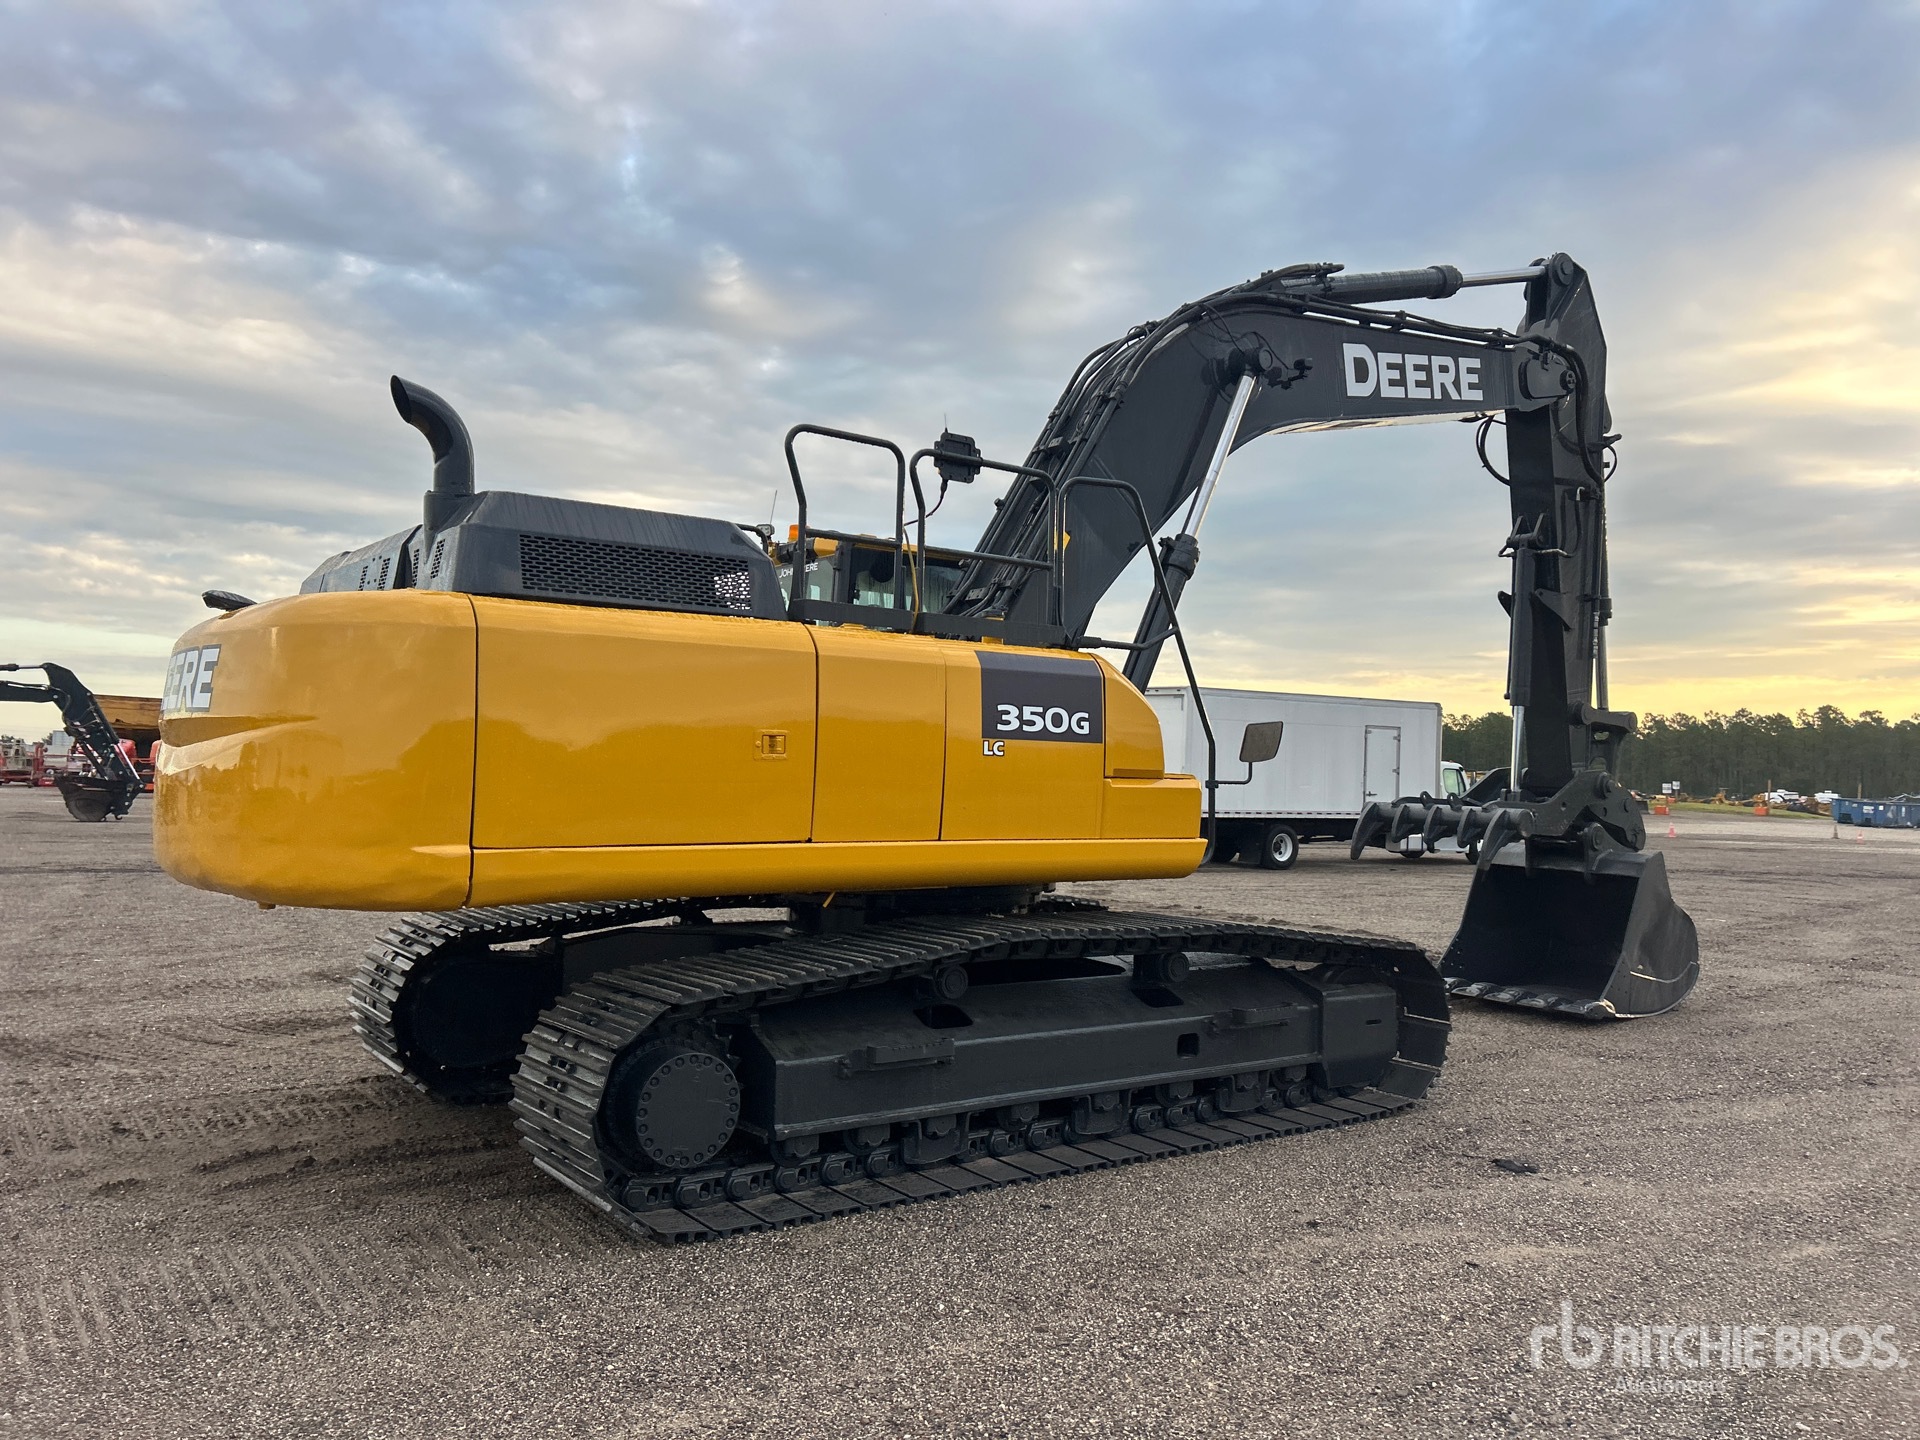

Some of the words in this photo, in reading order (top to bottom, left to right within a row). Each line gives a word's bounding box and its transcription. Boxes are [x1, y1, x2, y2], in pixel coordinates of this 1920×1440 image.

[1342, 342, 1484, 401] DEERE
[996, 704, 1090, 735] 350G
[982, 740, 1005, 756] LC
